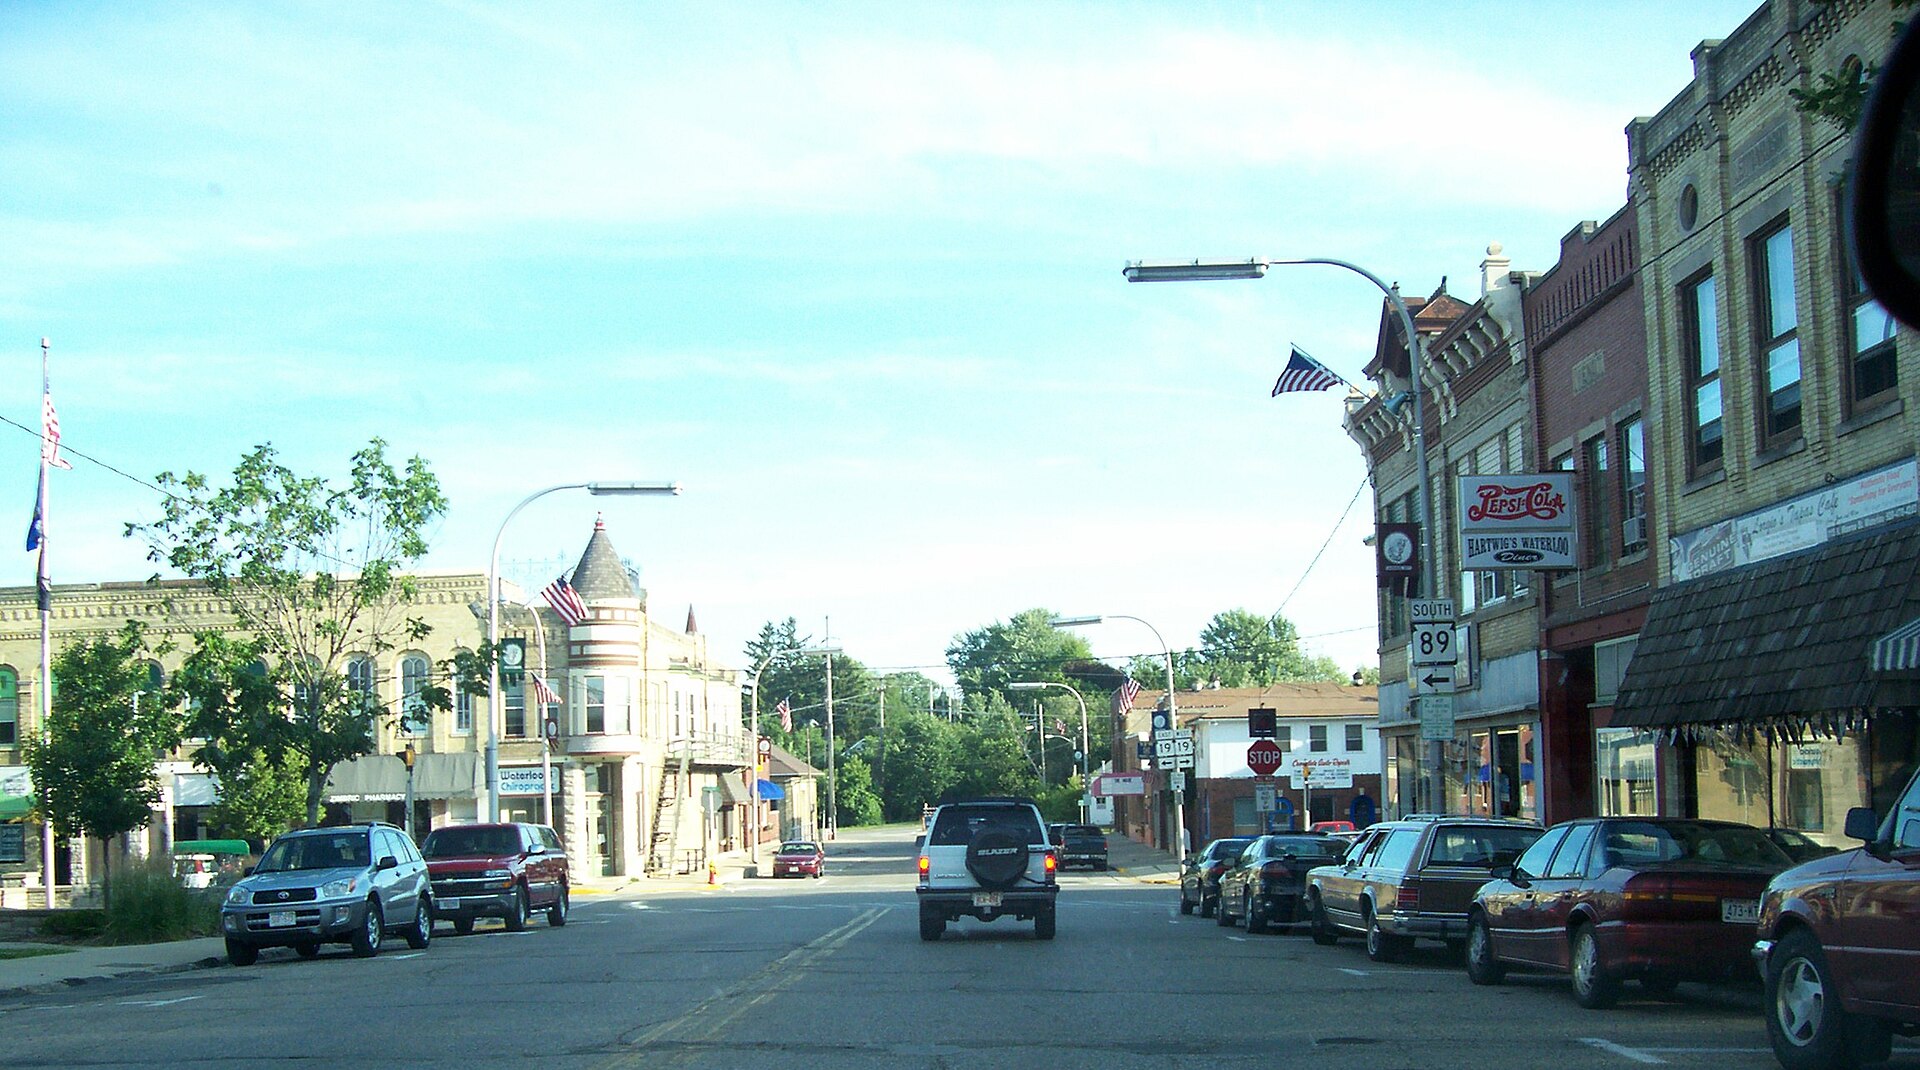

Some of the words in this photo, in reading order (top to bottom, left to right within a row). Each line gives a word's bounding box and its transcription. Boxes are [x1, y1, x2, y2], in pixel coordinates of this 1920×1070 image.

[1468, 537, 1518, 558] HARTWIG'S
[1522, 536, 1569, 556] WATERLOO
[1687, 532, 1738, 573] GENUINE
[1688, 548, 1731, 578] DRAFT
[1413, 603, 1452, 616] SOUTH
[1420, 630, 1449, 655] 89
[1160, 743, 1171, 753] 19
[1178, 741, 1189, 751] 19
[1249, 751, 1280, 764] STOP
[364, 793, 406, 802] PHARMACY
[978, 848, 1018, 856] BLAZER
